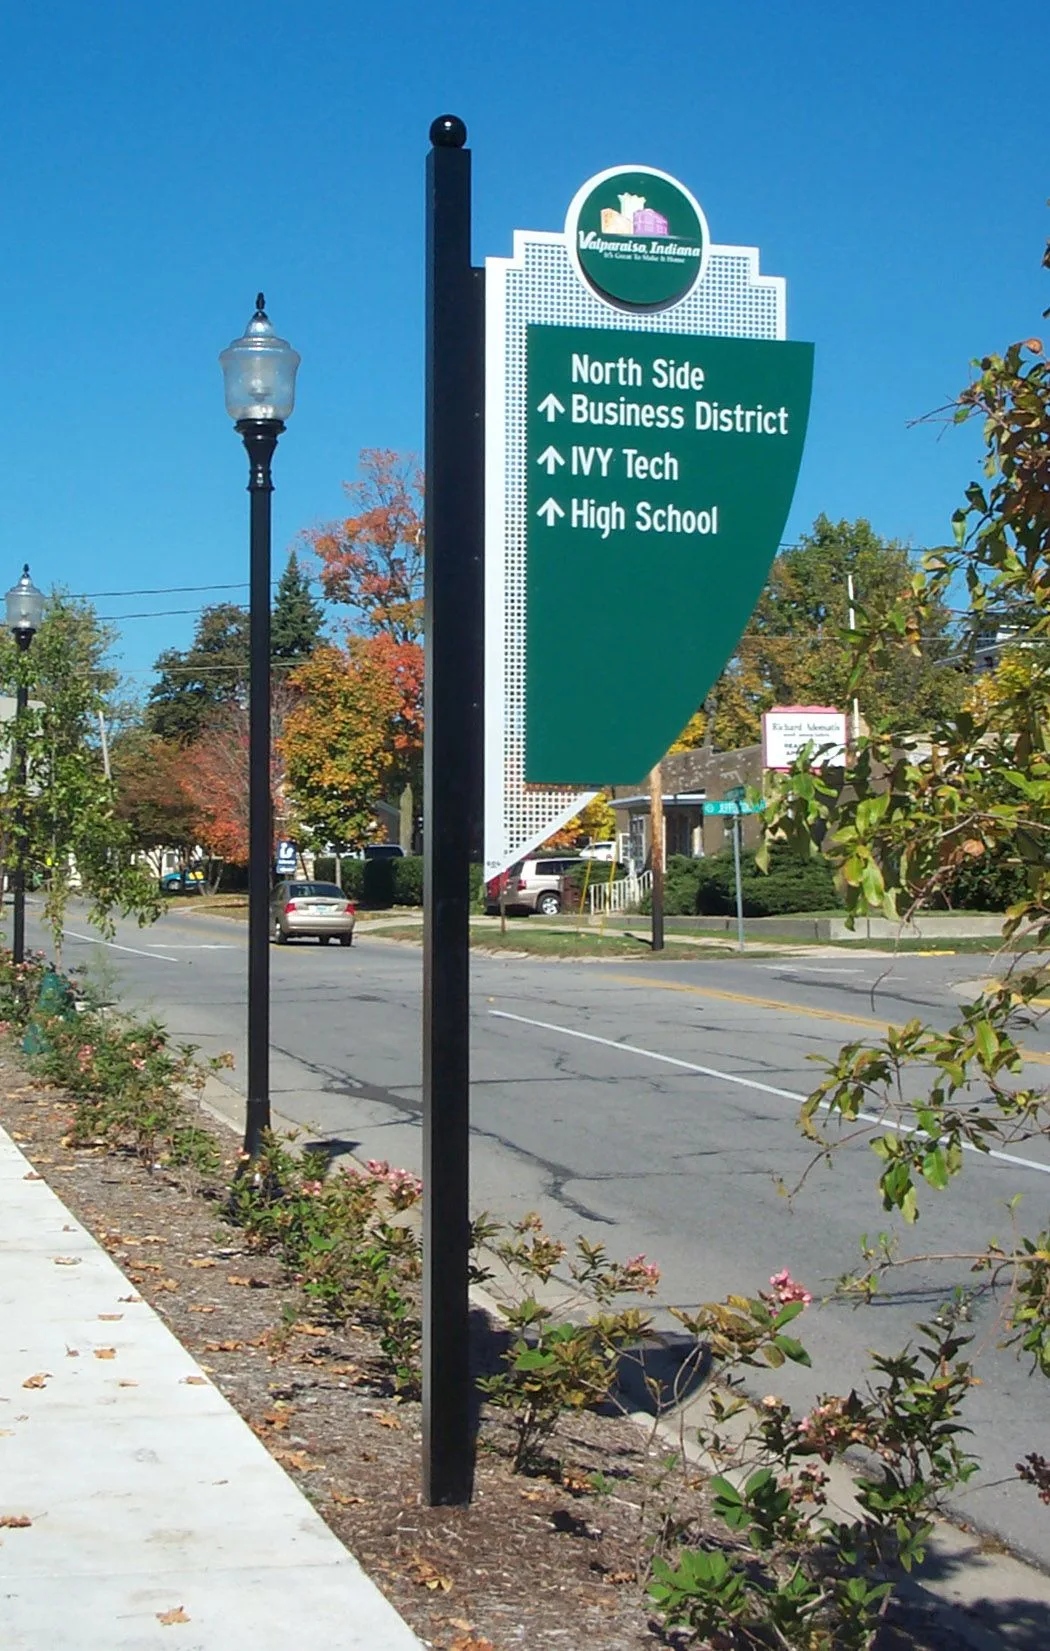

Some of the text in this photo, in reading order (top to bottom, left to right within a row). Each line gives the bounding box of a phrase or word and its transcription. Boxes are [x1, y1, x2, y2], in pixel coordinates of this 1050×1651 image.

[578, 230, 701, 257] Valparaiso, Indiana
[615, 252, 632, 260] Great
[643, 254, 659, 262] Make
[571, 353, 705, 390] North Side
[571, 393, 789, 435] Business District
[571, 446, 679, 481] IVY Tech
[571, 498, 718, 539] High School
[772, 722, 802, 731] Richard
